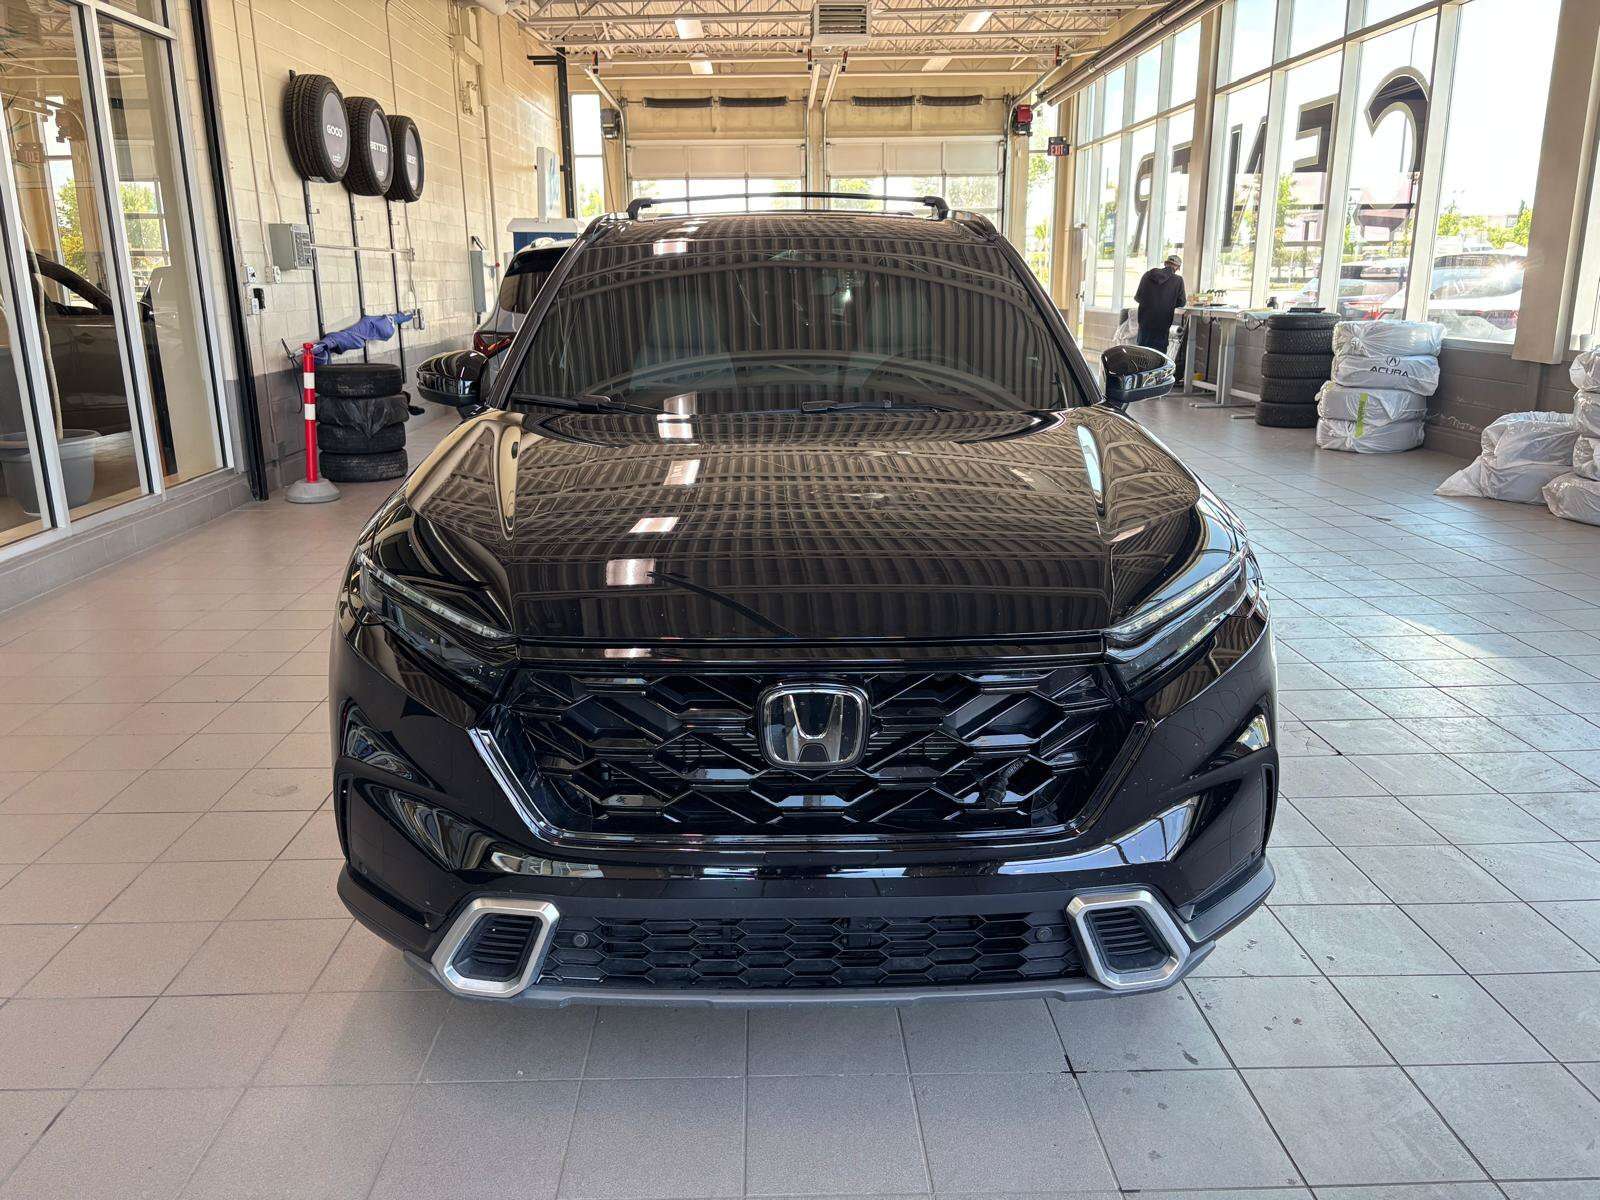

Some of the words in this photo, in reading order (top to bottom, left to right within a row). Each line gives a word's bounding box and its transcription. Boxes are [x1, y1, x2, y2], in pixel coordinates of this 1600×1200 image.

[326, 124, 343, 138] GOOD
[370, 141, 388, 154] BETTER
[1051, 144, 1065, 156] EXIT
[1369, 365, 1409, 378] ACURA
